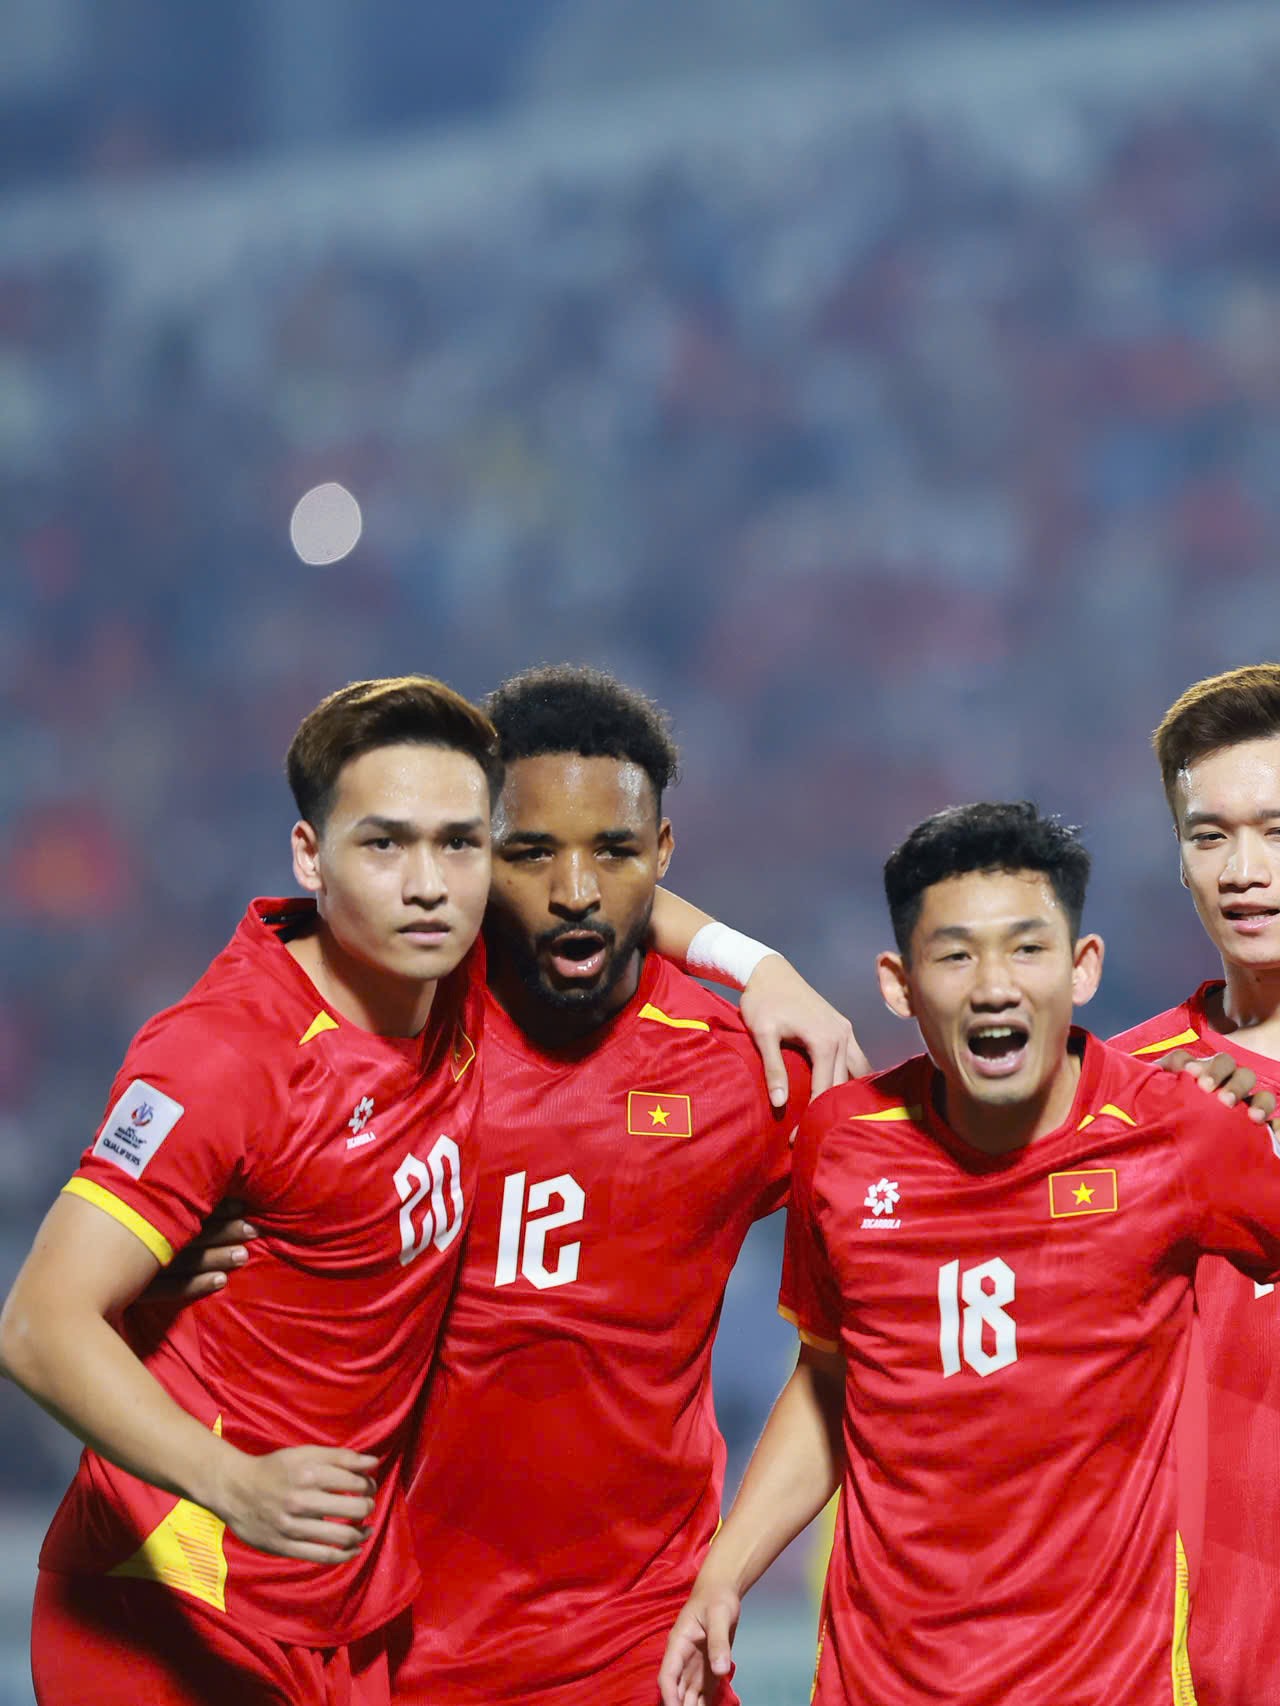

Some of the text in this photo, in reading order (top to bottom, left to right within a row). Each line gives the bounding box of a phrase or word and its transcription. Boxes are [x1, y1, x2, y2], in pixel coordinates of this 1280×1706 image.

[392, 1134, 464, 1267] 20
[494, 1170, 586, 1290] 12
[937, 1257, 1018, 1379] 18
